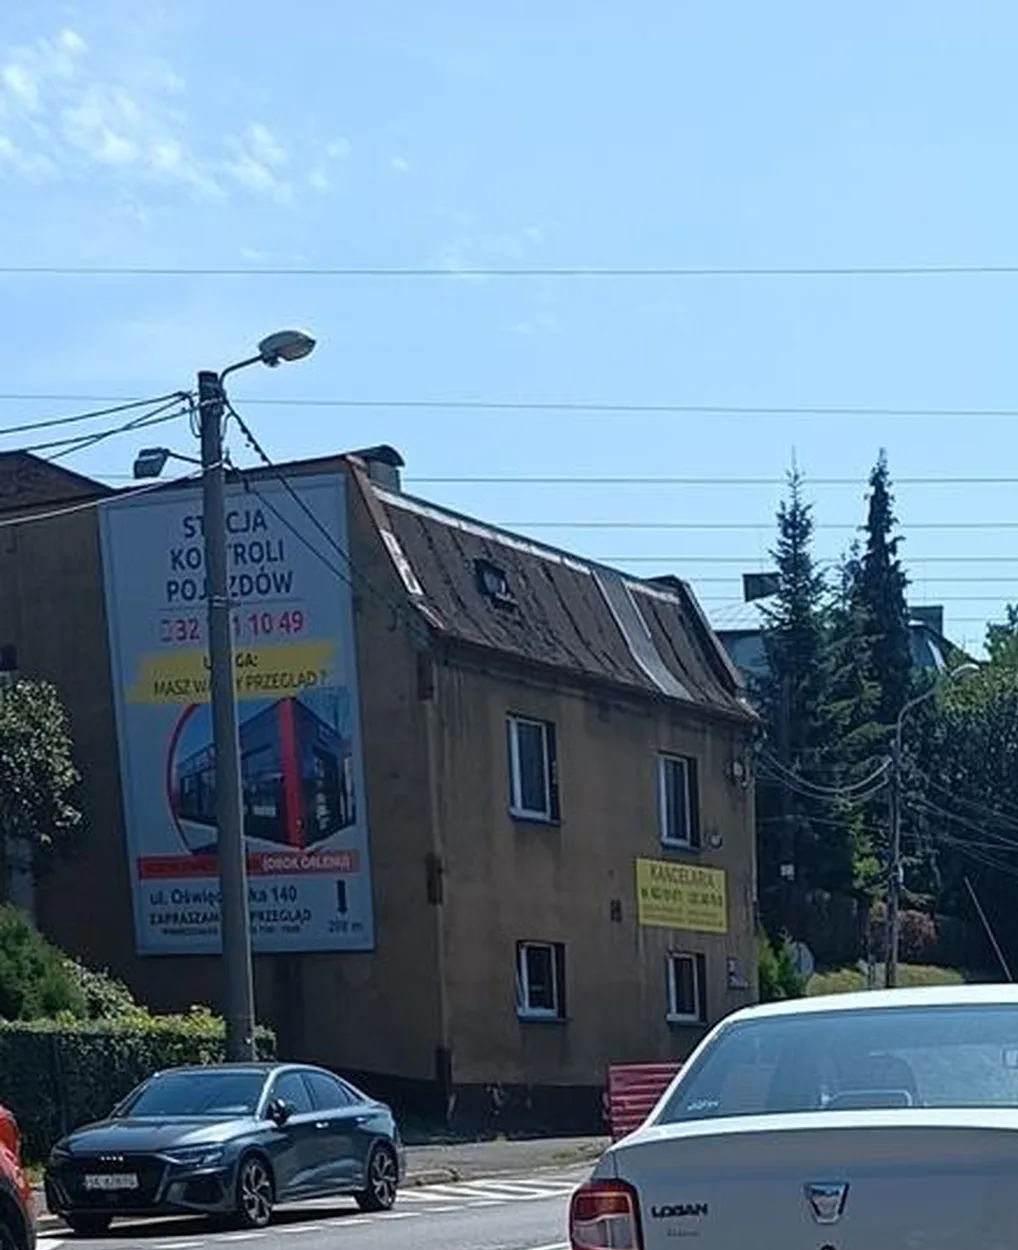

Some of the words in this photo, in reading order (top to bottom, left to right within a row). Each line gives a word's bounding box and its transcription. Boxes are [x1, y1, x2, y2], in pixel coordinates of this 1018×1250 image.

[183, 509, 268, 539] STCJA
[170, 540, 284, 570] KOROLI
[166, 565, 294, 603] POJZDÓW
[249, 612, 272, 635] 10
[278, 610, 304, 634] 49
[203, 653, 258, 670] UGA:
[273, 885, 298, 901] 140
[651, 1203, 709, 1218] LOGAN
